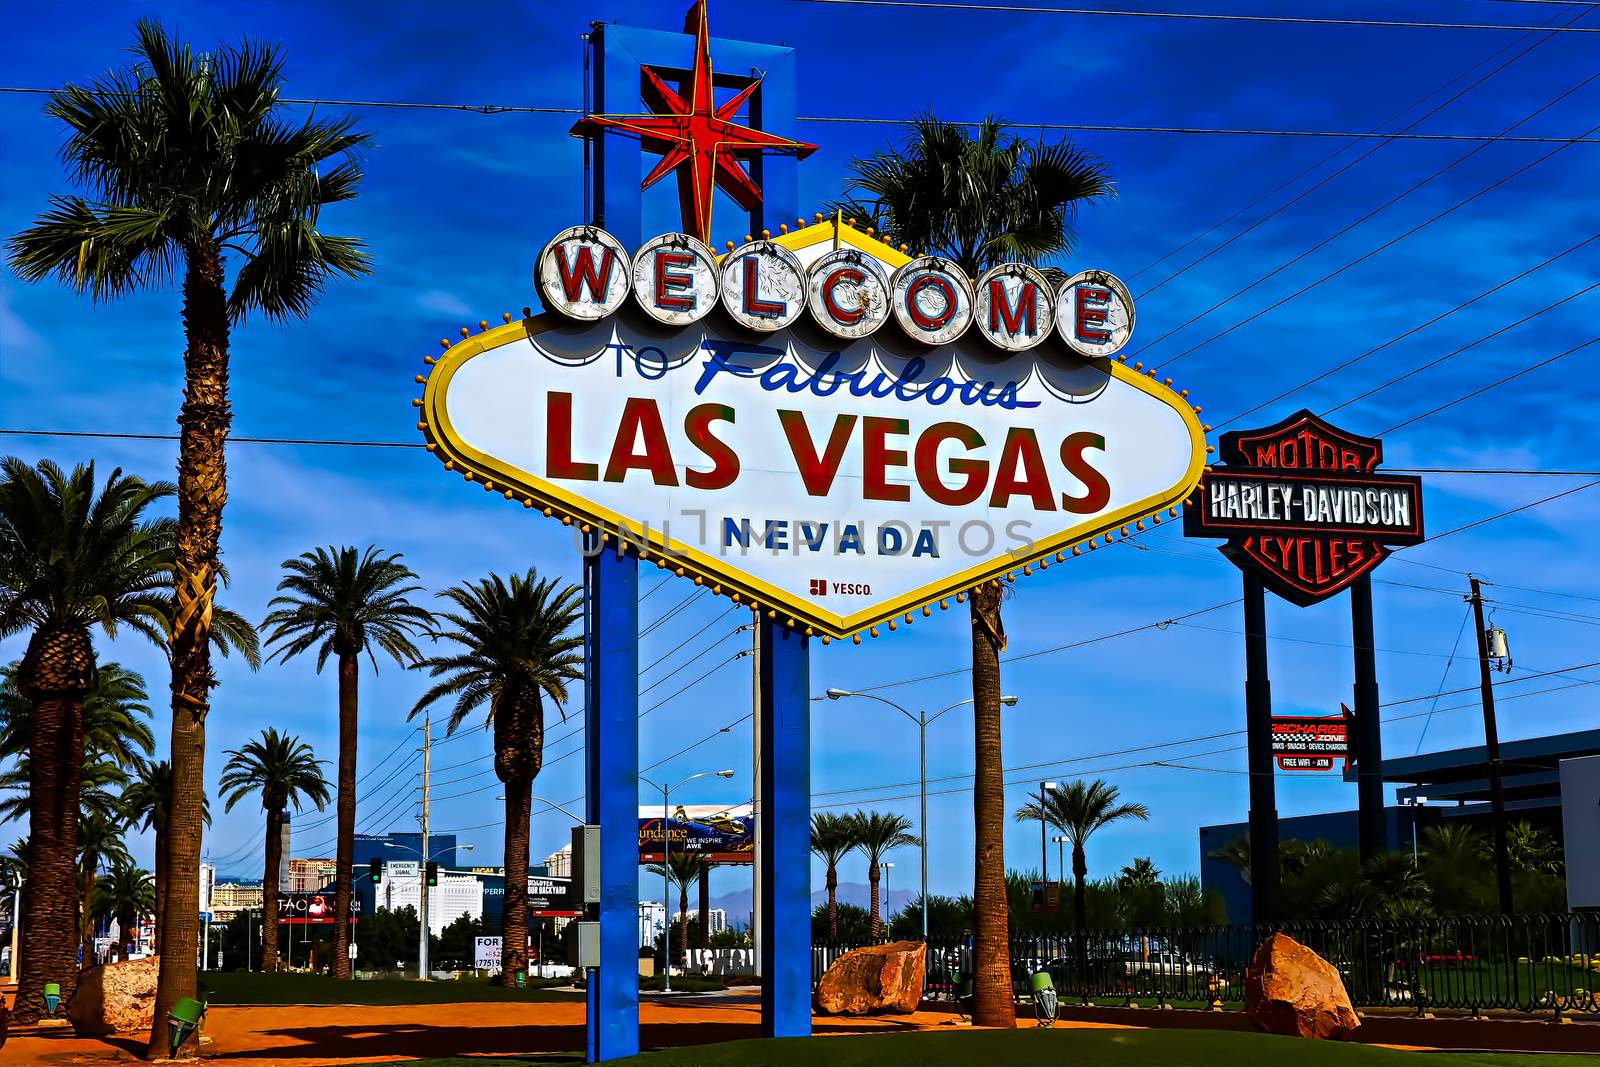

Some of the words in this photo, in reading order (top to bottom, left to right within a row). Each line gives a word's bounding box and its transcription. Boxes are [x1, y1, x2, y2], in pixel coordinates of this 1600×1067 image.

[553, 244, 1112, 344] WELCOME
[606, 344, 669, 380] TO
[694, 339, 1042, 409] Fabulous
[546, 391, 740, 490] LAS
[776, 409, 1111, 515] VEGAS
[1257, 430, 1361, 473] MOTOR
[1210, 479, 1411, 526] HARLEY-DAVIDSON
[723, 516, 940, 559] NEVADA
[1260, 535, 1365, 585] CYCLES
[1283, 758, 1297, 767] FREE
[1316, 759, 1329, 767] ATM
[277, 898, 307, 911] TAO
[539, 886, 566, 894] BACKYARD
[477, 938, 499, 946] FOR
